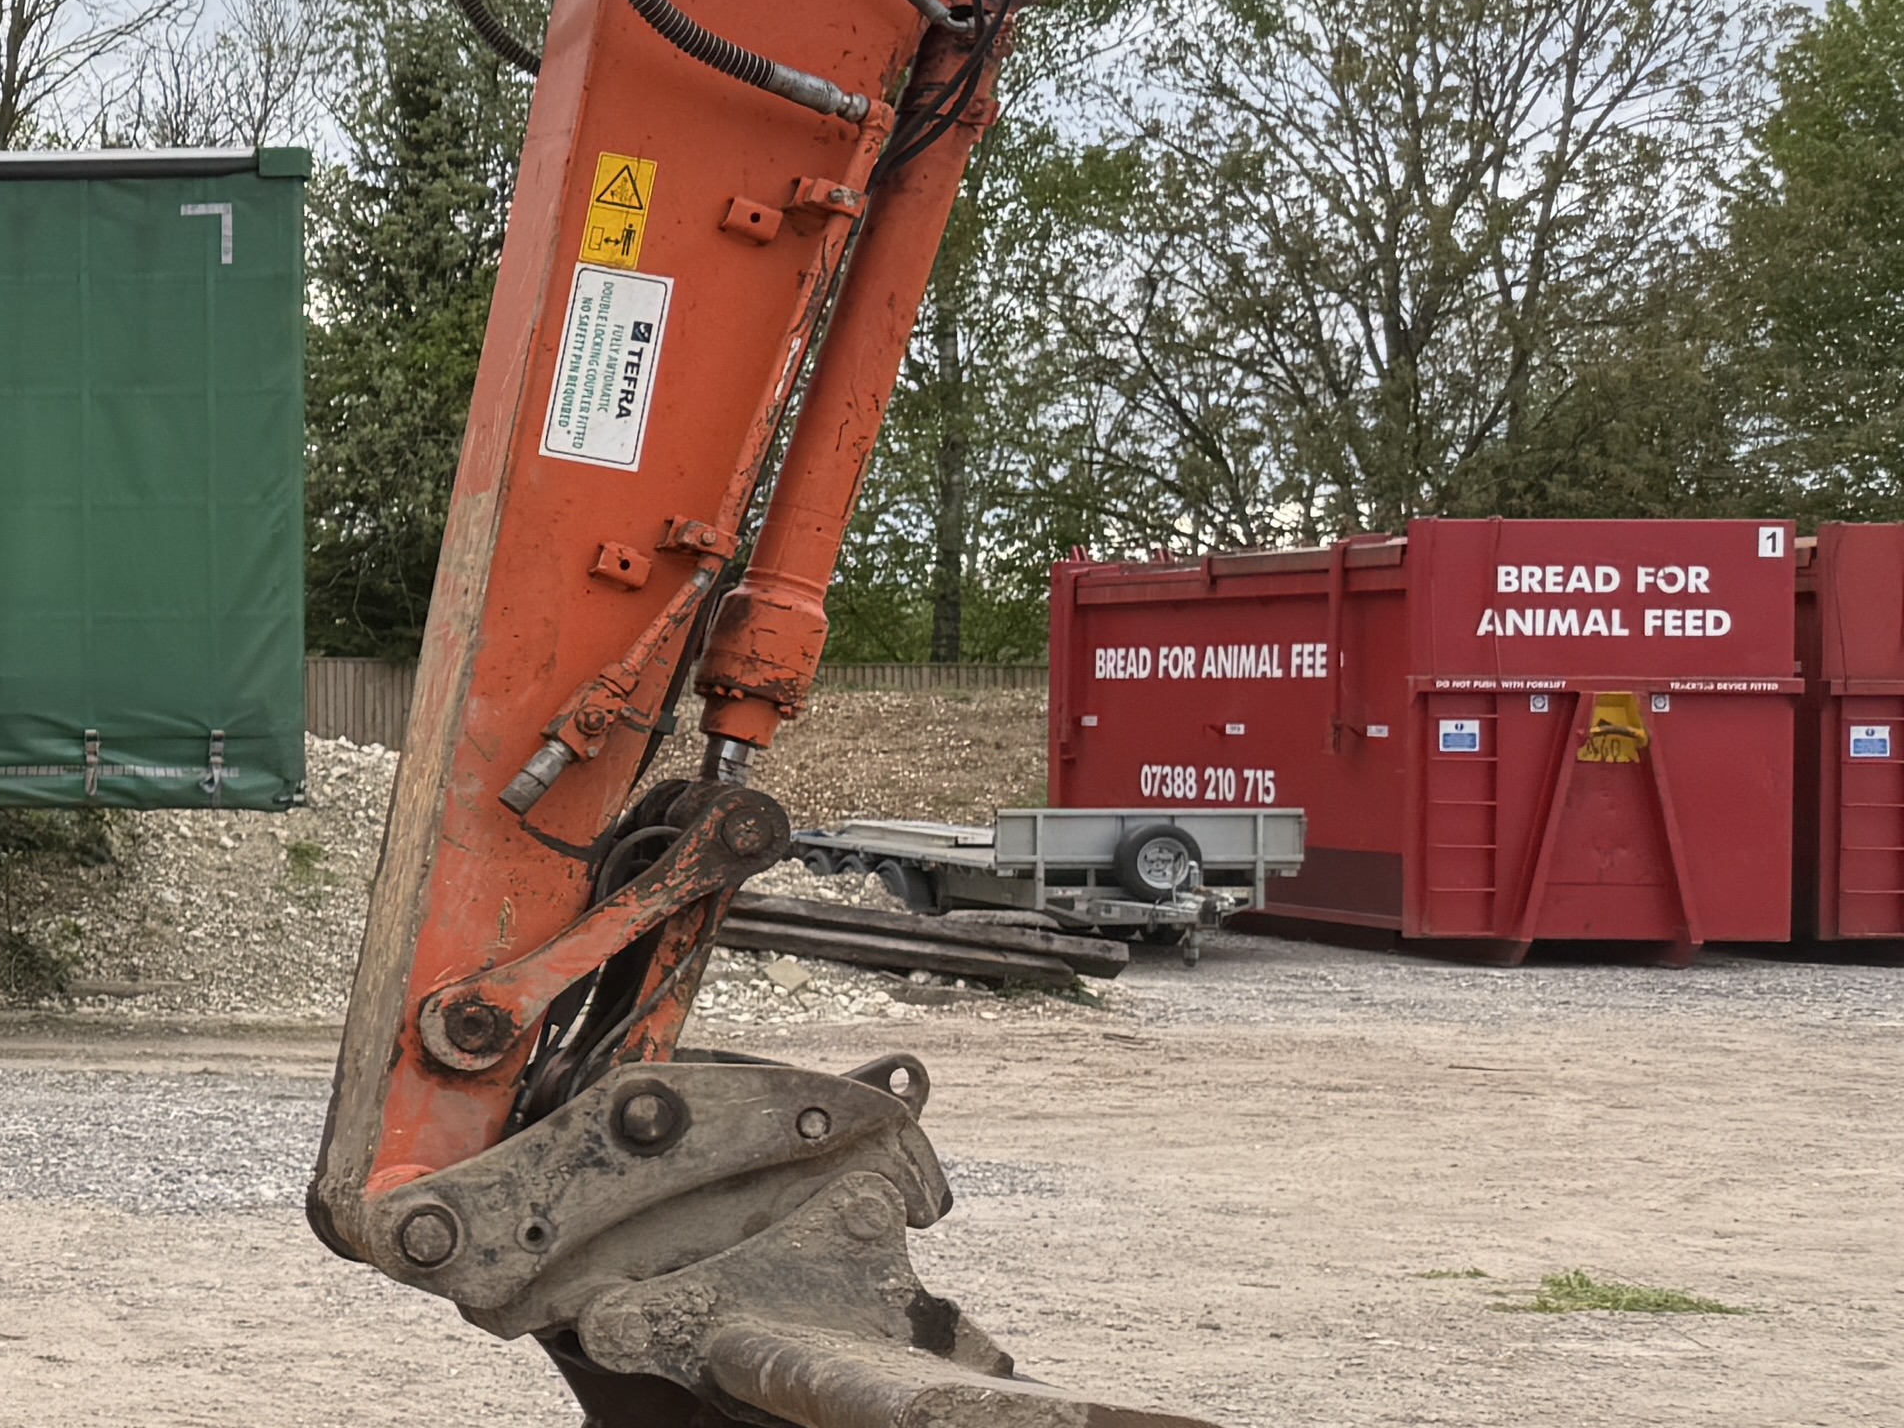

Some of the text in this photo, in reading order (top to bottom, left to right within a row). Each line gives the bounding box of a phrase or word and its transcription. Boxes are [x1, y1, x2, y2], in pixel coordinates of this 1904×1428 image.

[558, 297, 592, 428] NO SAFETY PIN REQUIRED
[572, 281, 614, 449] DOUBLE LOCKING COUPLER FITTED
[597, 324, 625, 413] FULLY AUTOMATIC
[616, 346, 644, 419] TEFRA
[1765, 531, 1779, 553] 1
[1496, 564, 1711, 594] BREAD FOR
[1476, 608, 1732, 637] ANIMAL FEED
[1095, 643, 1344, 679] BREAD FOR ANIMAL FEE
[1435, 680, 1449, 689] DO
[1452, 680, 1471, 689] NOT
[1716, 682, 1747, 690] DEVICE
[1140, 764, 1275, 805] 07388 210 715
